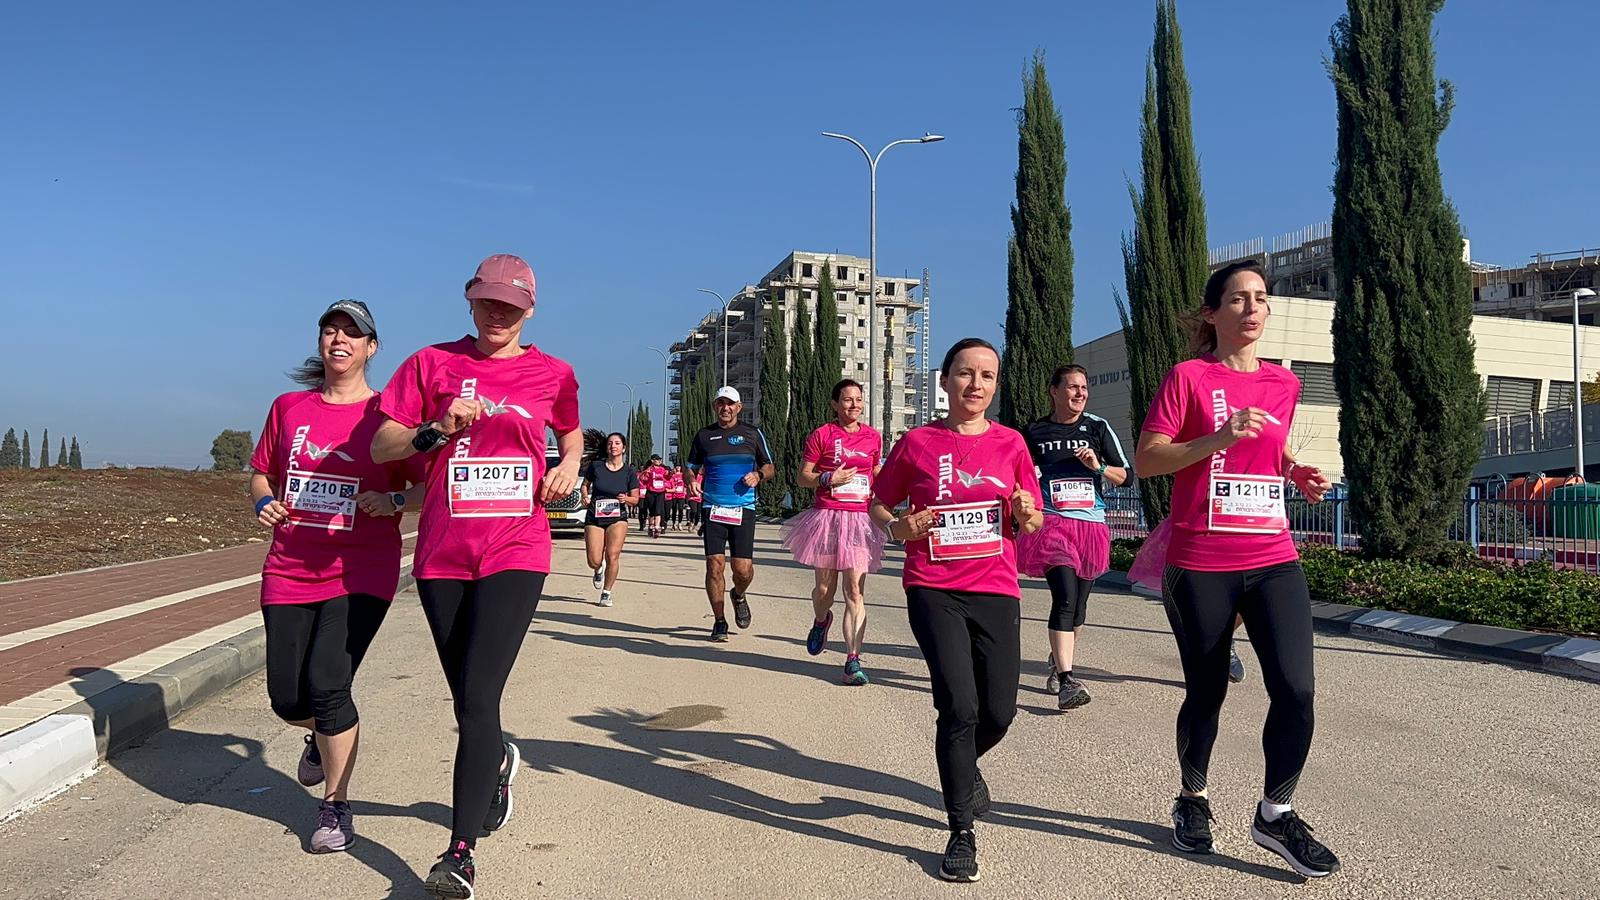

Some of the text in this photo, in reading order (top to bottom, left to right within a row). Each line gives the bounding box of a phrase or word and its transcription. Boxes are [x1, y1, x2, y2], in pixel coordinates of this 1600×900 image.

[1037, 439, 1090, 454] פנו דרך
[473, 467, 510, 480] 1207
[936, 453, 952, 501] בשביל
[303, 481, 337, 495] 1210
[1063, 482, 1082, 490] 1061
[1235, 484, 1265, 497] 1211
[949, 511, 983, 525] 1129
